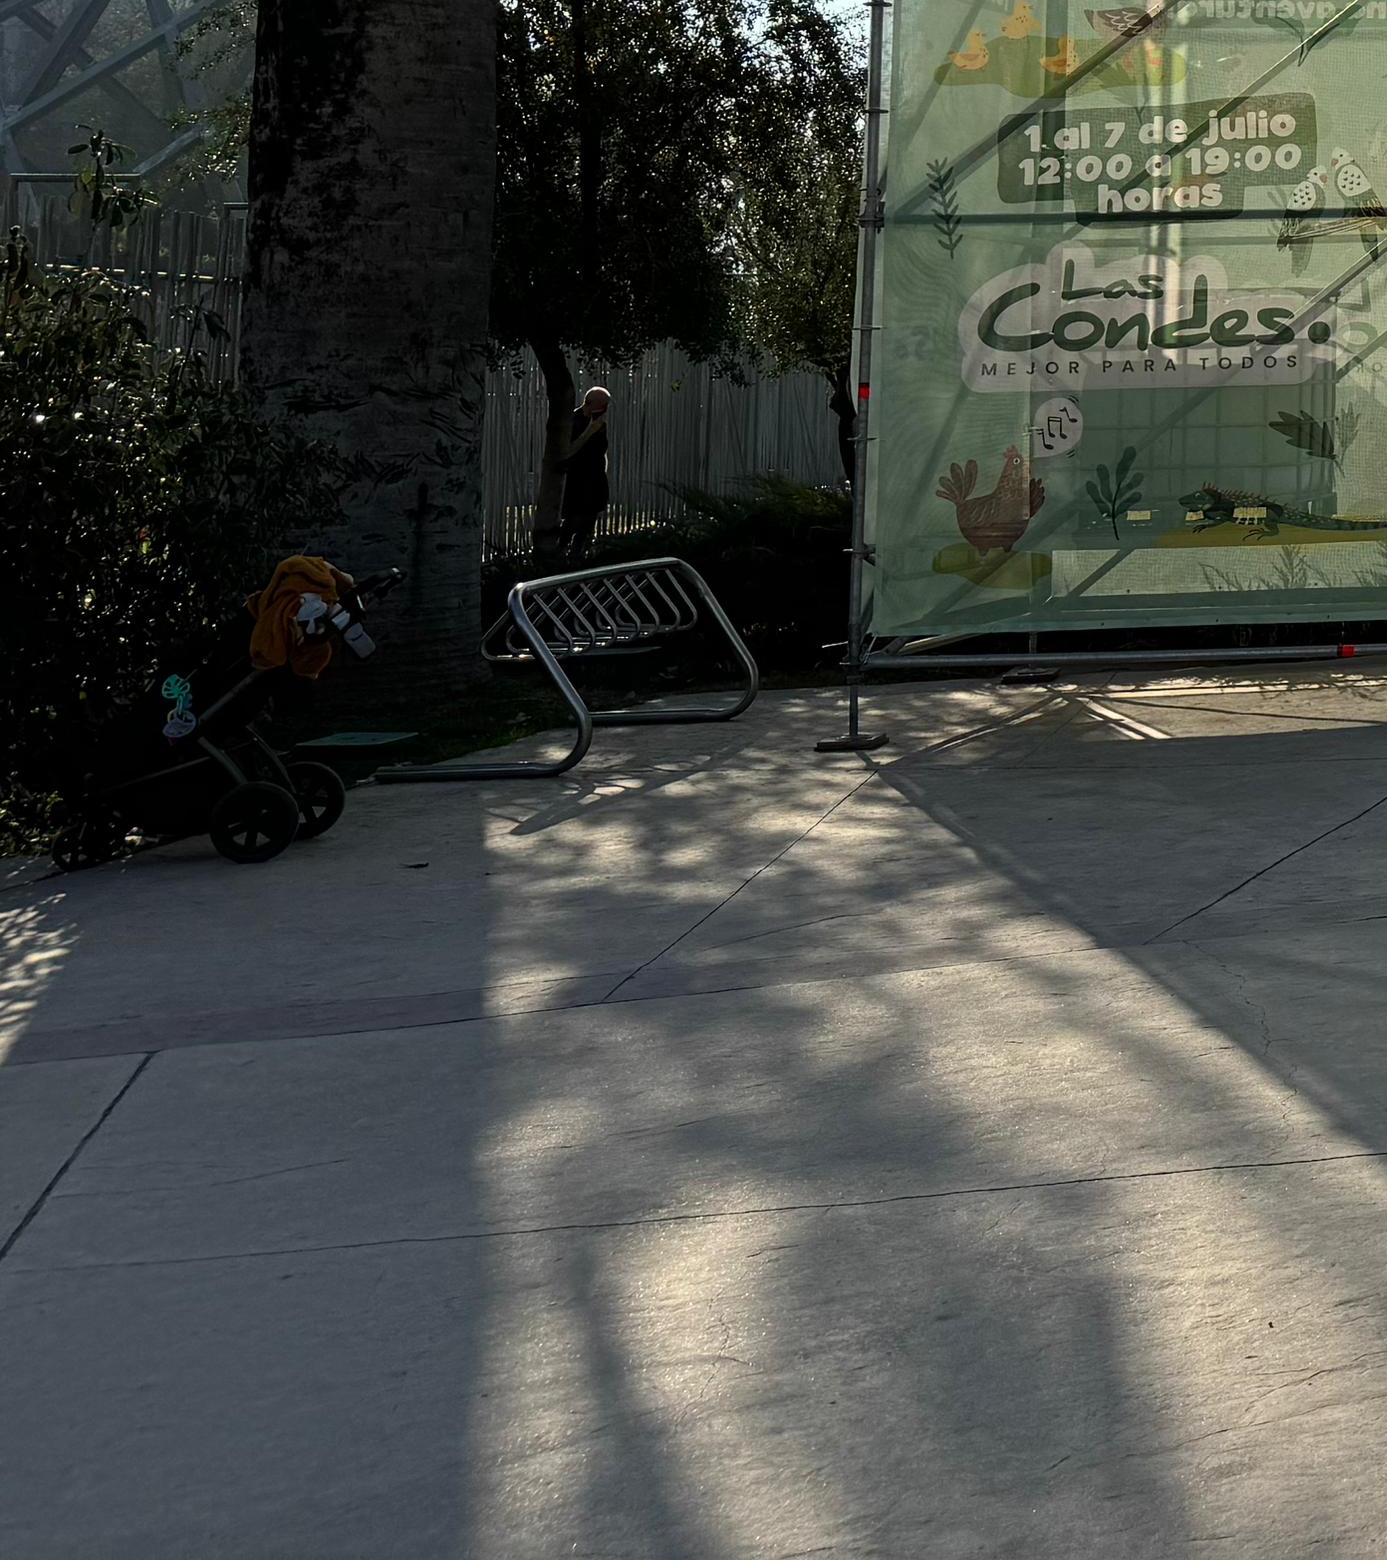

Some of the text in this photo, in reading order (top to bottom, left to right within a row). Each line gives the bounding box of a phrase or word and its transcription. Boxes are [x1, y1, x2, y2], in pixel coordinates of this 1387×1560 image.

[1024, 109, 1296, 152] 1 al 7 de julio
[1018, 143, 1302, 186] 12:00 a 19:00
[1098, 183, 1223, 214] horas
[1061, 259, 1164, 300] Las
[981, 354, 1298, 377] MEJOR PARA TODOS
